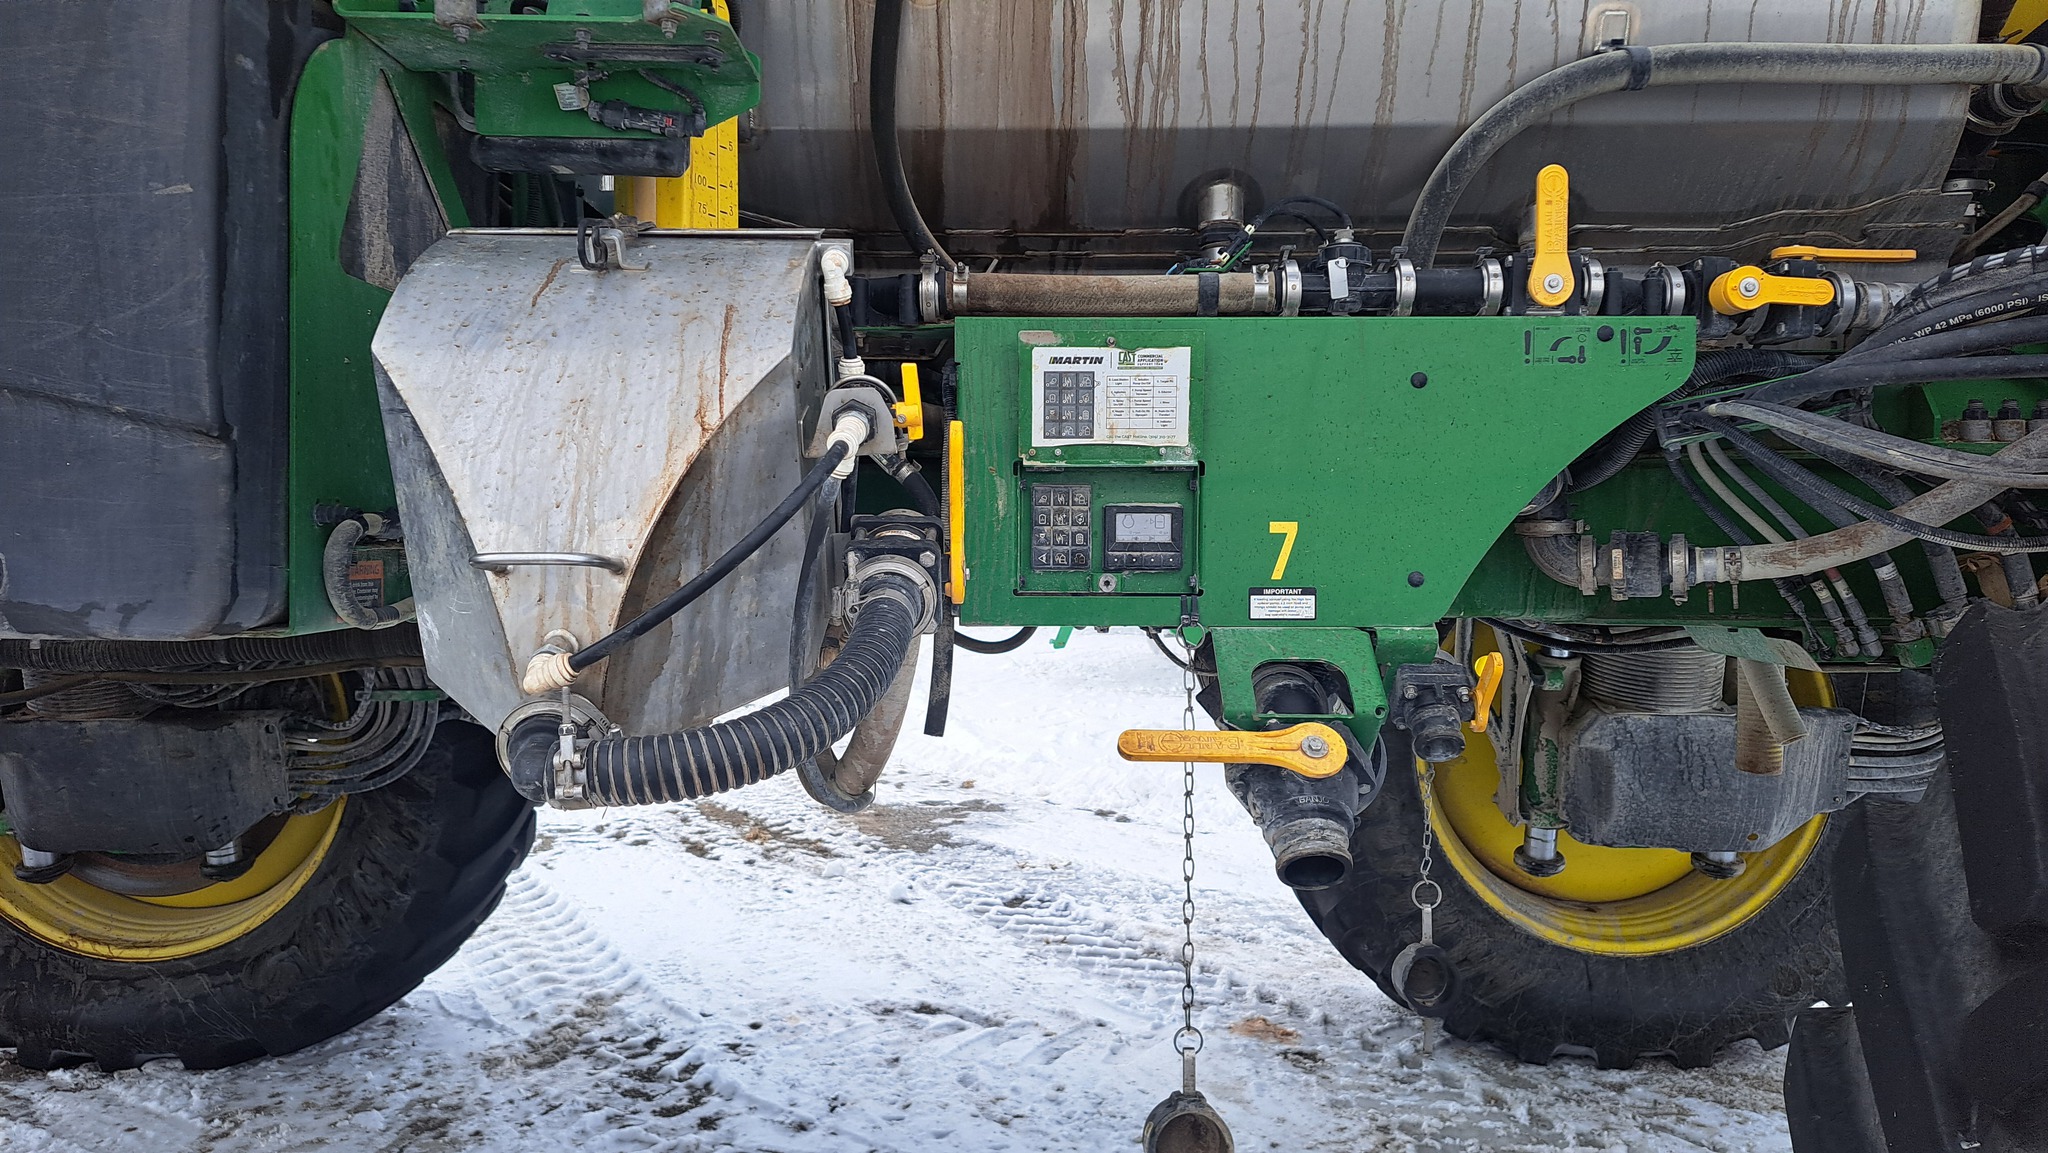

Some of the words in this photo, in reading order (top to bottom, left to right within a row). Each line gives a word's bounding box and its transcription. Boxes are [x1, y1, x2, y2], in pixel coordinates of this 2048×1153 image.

[728, 141, 734, 152] 5
[694, 173, 707, 187] 100
[728, 180, 734, 190] 4
[697, 202, 707, 215] 75
[728, 206, 734, 217] 3
[1913, 326, 1932, 338] WP
[1934, 321, 1948, 331] 42
[1949, 312, 1973, 326] MPa
[1974, 303, 2005, 319] (6000
[2006, 296, 2029, 309] PSI)
[1048, 356, 1105, 365] MARTIN
[1118, 351, 1137, 364] CAST
[1268, 521, 1299, 580] 7
